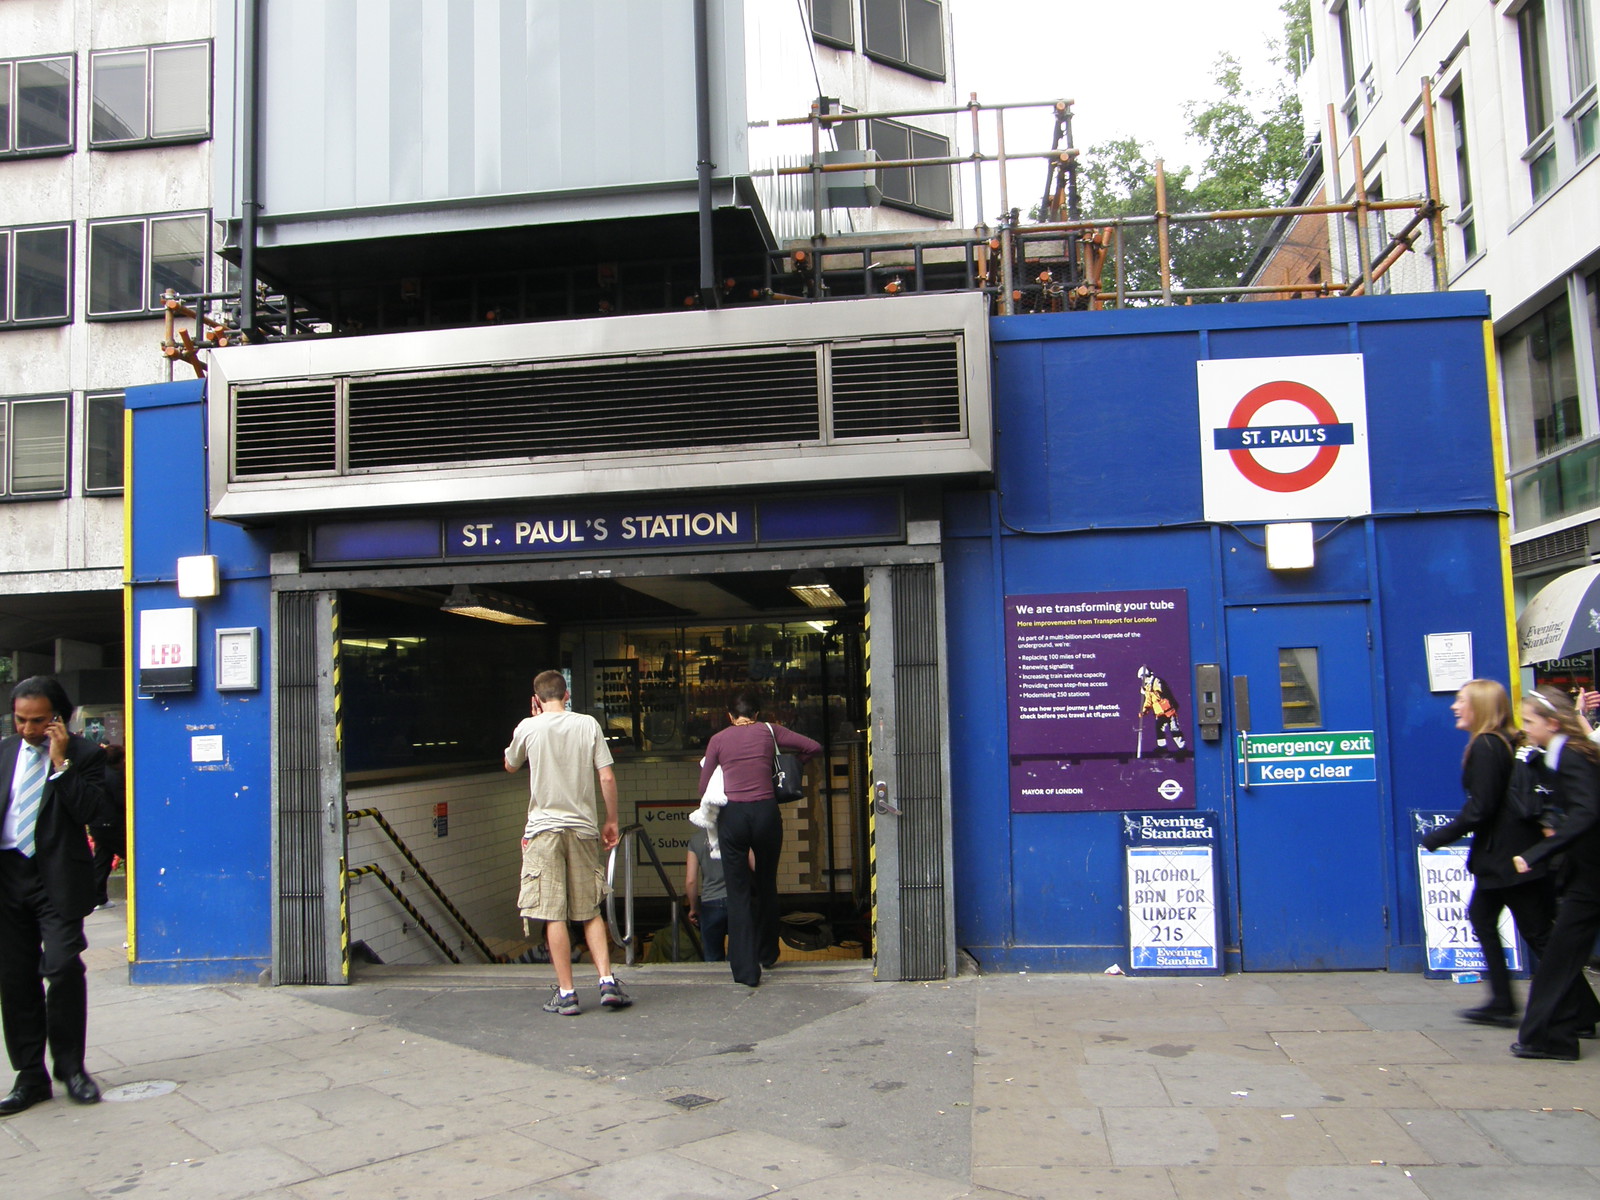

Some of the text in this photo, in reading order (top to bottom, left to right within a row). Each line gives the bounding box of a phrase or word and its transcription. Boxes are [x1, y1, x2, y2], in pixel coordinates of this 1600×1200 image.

[1242, 428, 1326, 444] ST. PAUL'S
[462, 512, 738, 547] ST. PAUL'S STATION
[1016, 600, 1175, 615] We are transforming your tube
[1526, 621, 1565, 638] Evening
[1522, 630, 1564, 650] Standard
[152, 644, 182, 665] LFB
[603, 670, 679, 681] DRY CEANING
[603, 683, 633, 692] SHIR
[604, 704, 677, 714] ALTEATIONS
[1242, 737, 1370, 756] Emergency exit
[1261, 764, 1352, 782] Keep clear
[1141, 816, 1205, 829] Evening
[1142, 827, 1214, 839] Standard
[658, 838, 689, 848] Subw
[1136, 868, 1200, 884] ALCOHOL
[1427, 868, 1473, 884] ALCOH
[1136, 889, 1205, 904] BAN FOR
[1428, 890, 1460, 904] BAN
[1144, 907, 1196, 920] UNDER
[1156, 948, 1202, 958] Evening
[1156, 956, 1208, 966] Standard
